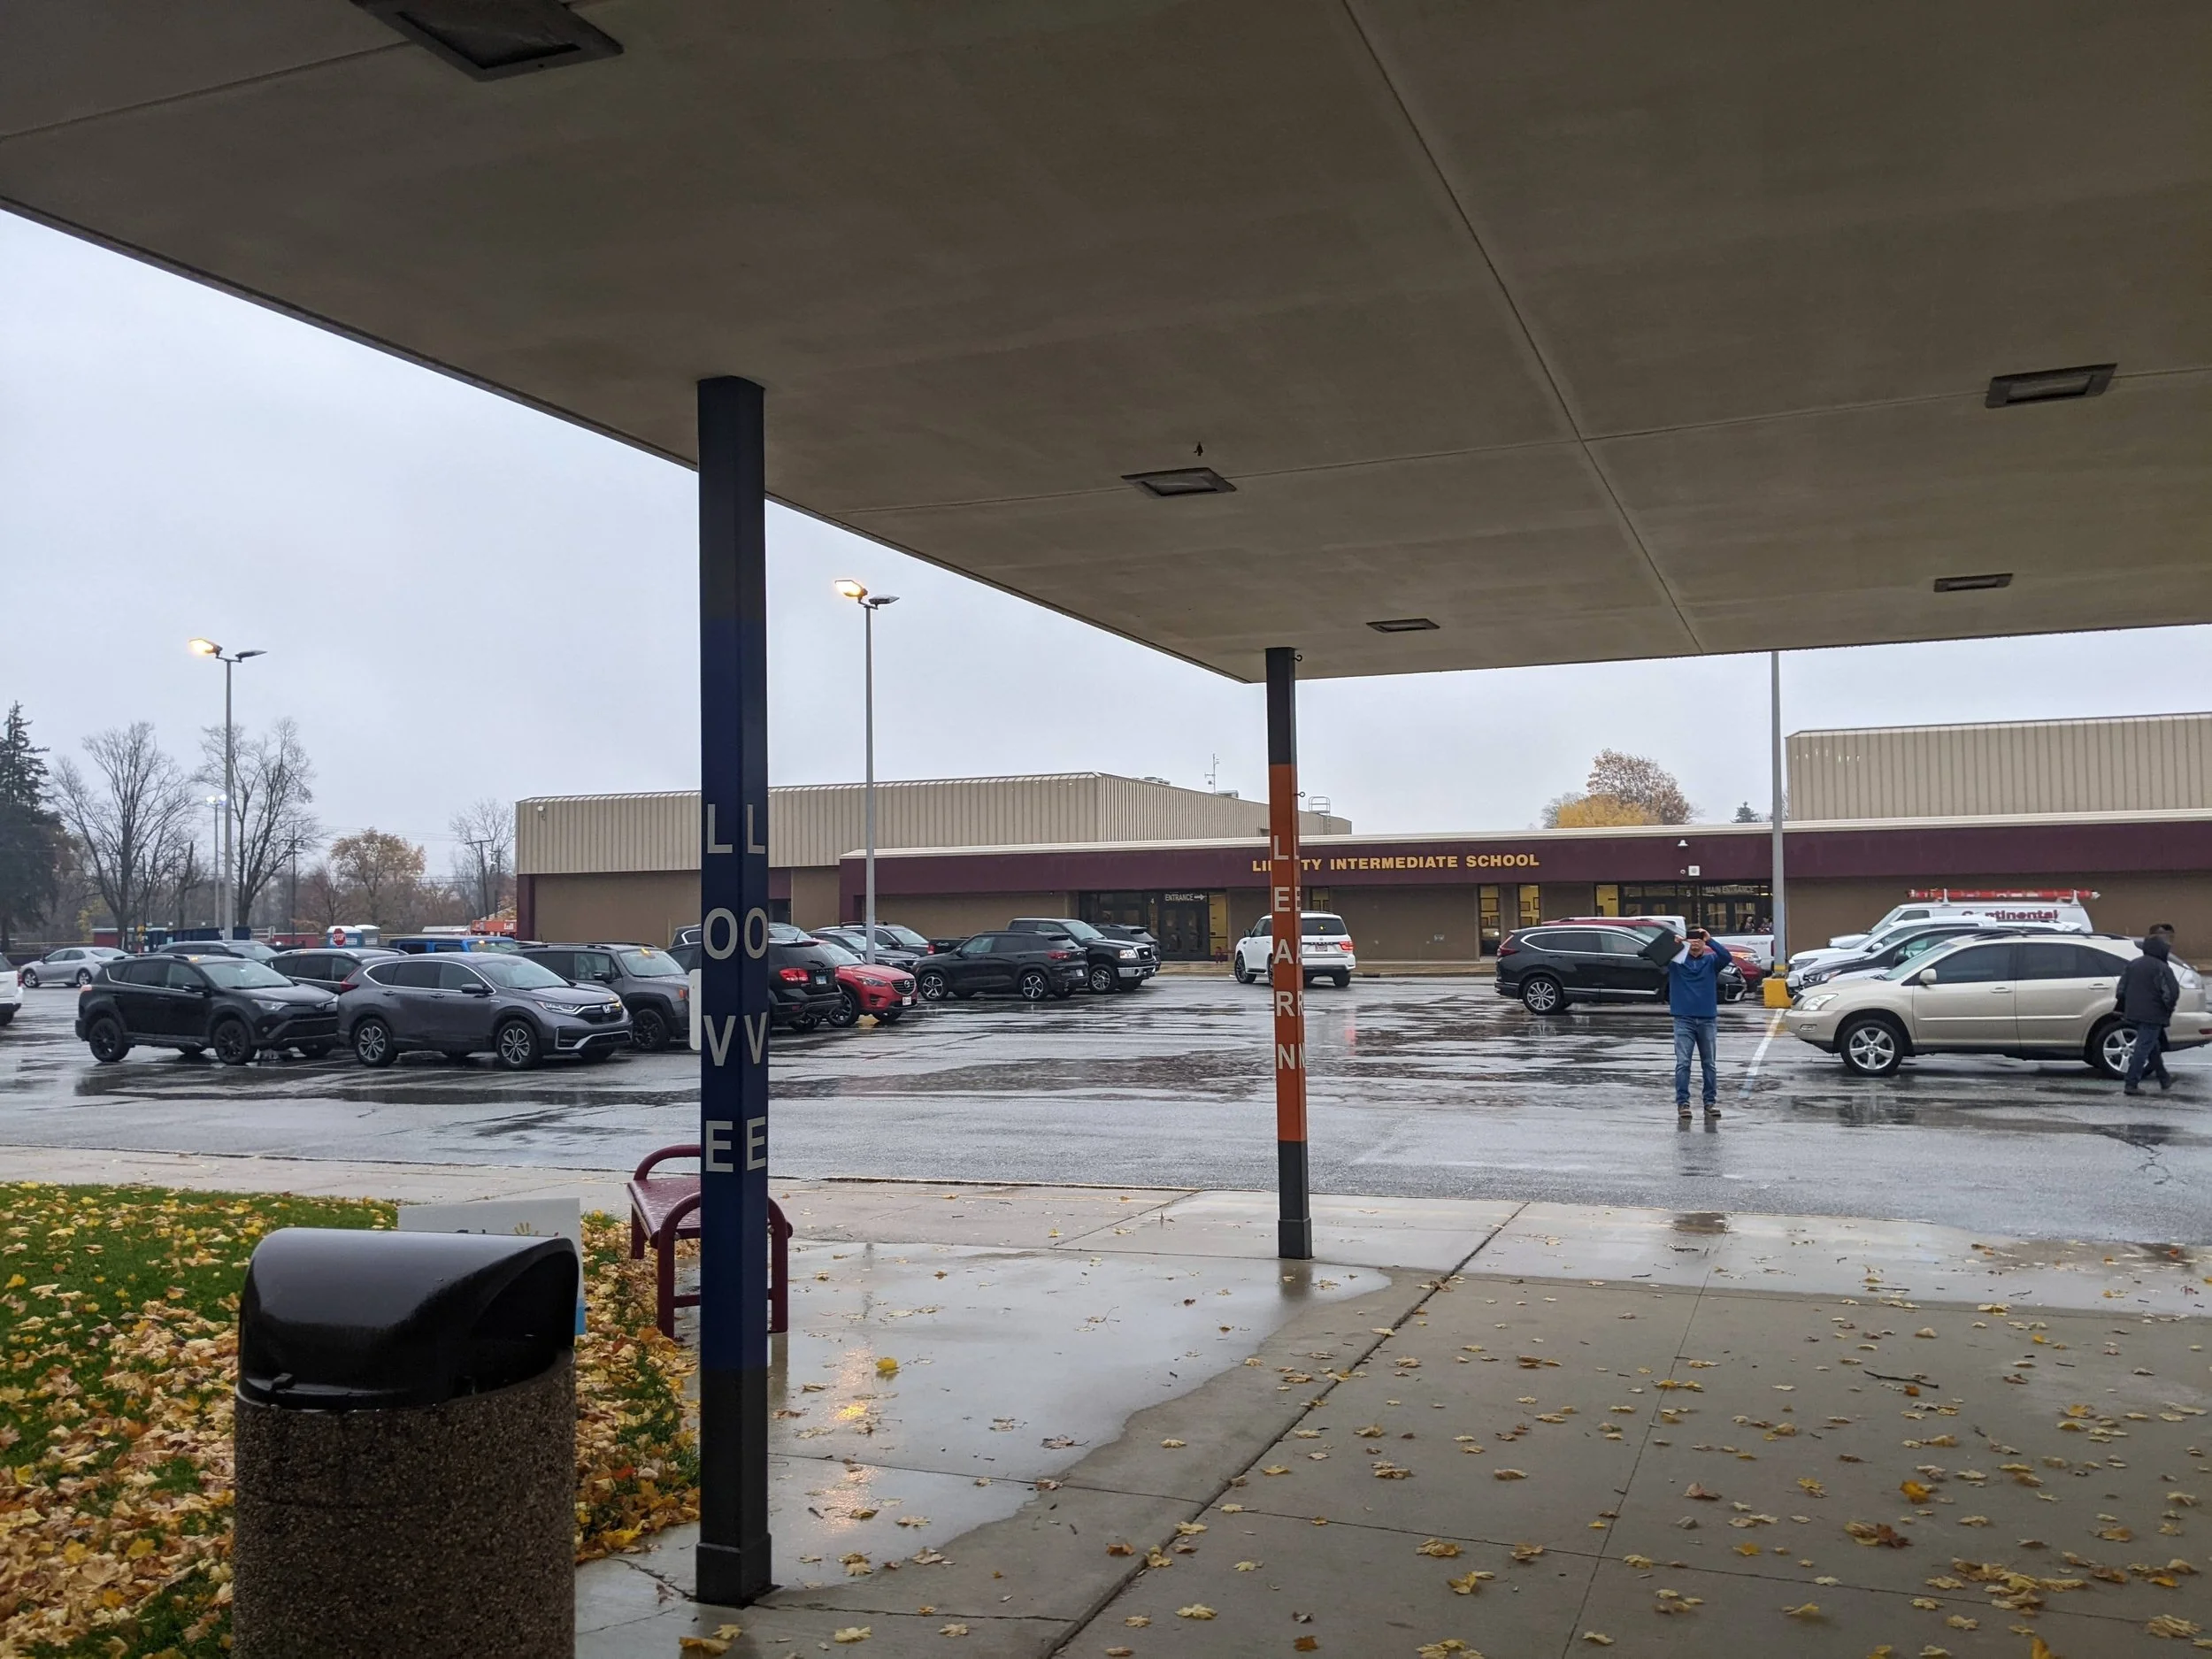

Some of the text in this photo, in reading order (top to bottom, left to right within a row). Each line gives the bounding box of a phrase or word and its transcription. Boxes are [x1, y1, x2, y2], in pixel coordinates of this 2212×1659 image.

[1253, 854, 1540, 872] LITY INTERMEDIATE SCHOOL
[1273, 834, 1294, 1069] LEARN
[1962, 910, 2058, 920] Cntinental
[703, 804, 738, 1172] LOVE
[744, 804, 768, 1171] LOVE
